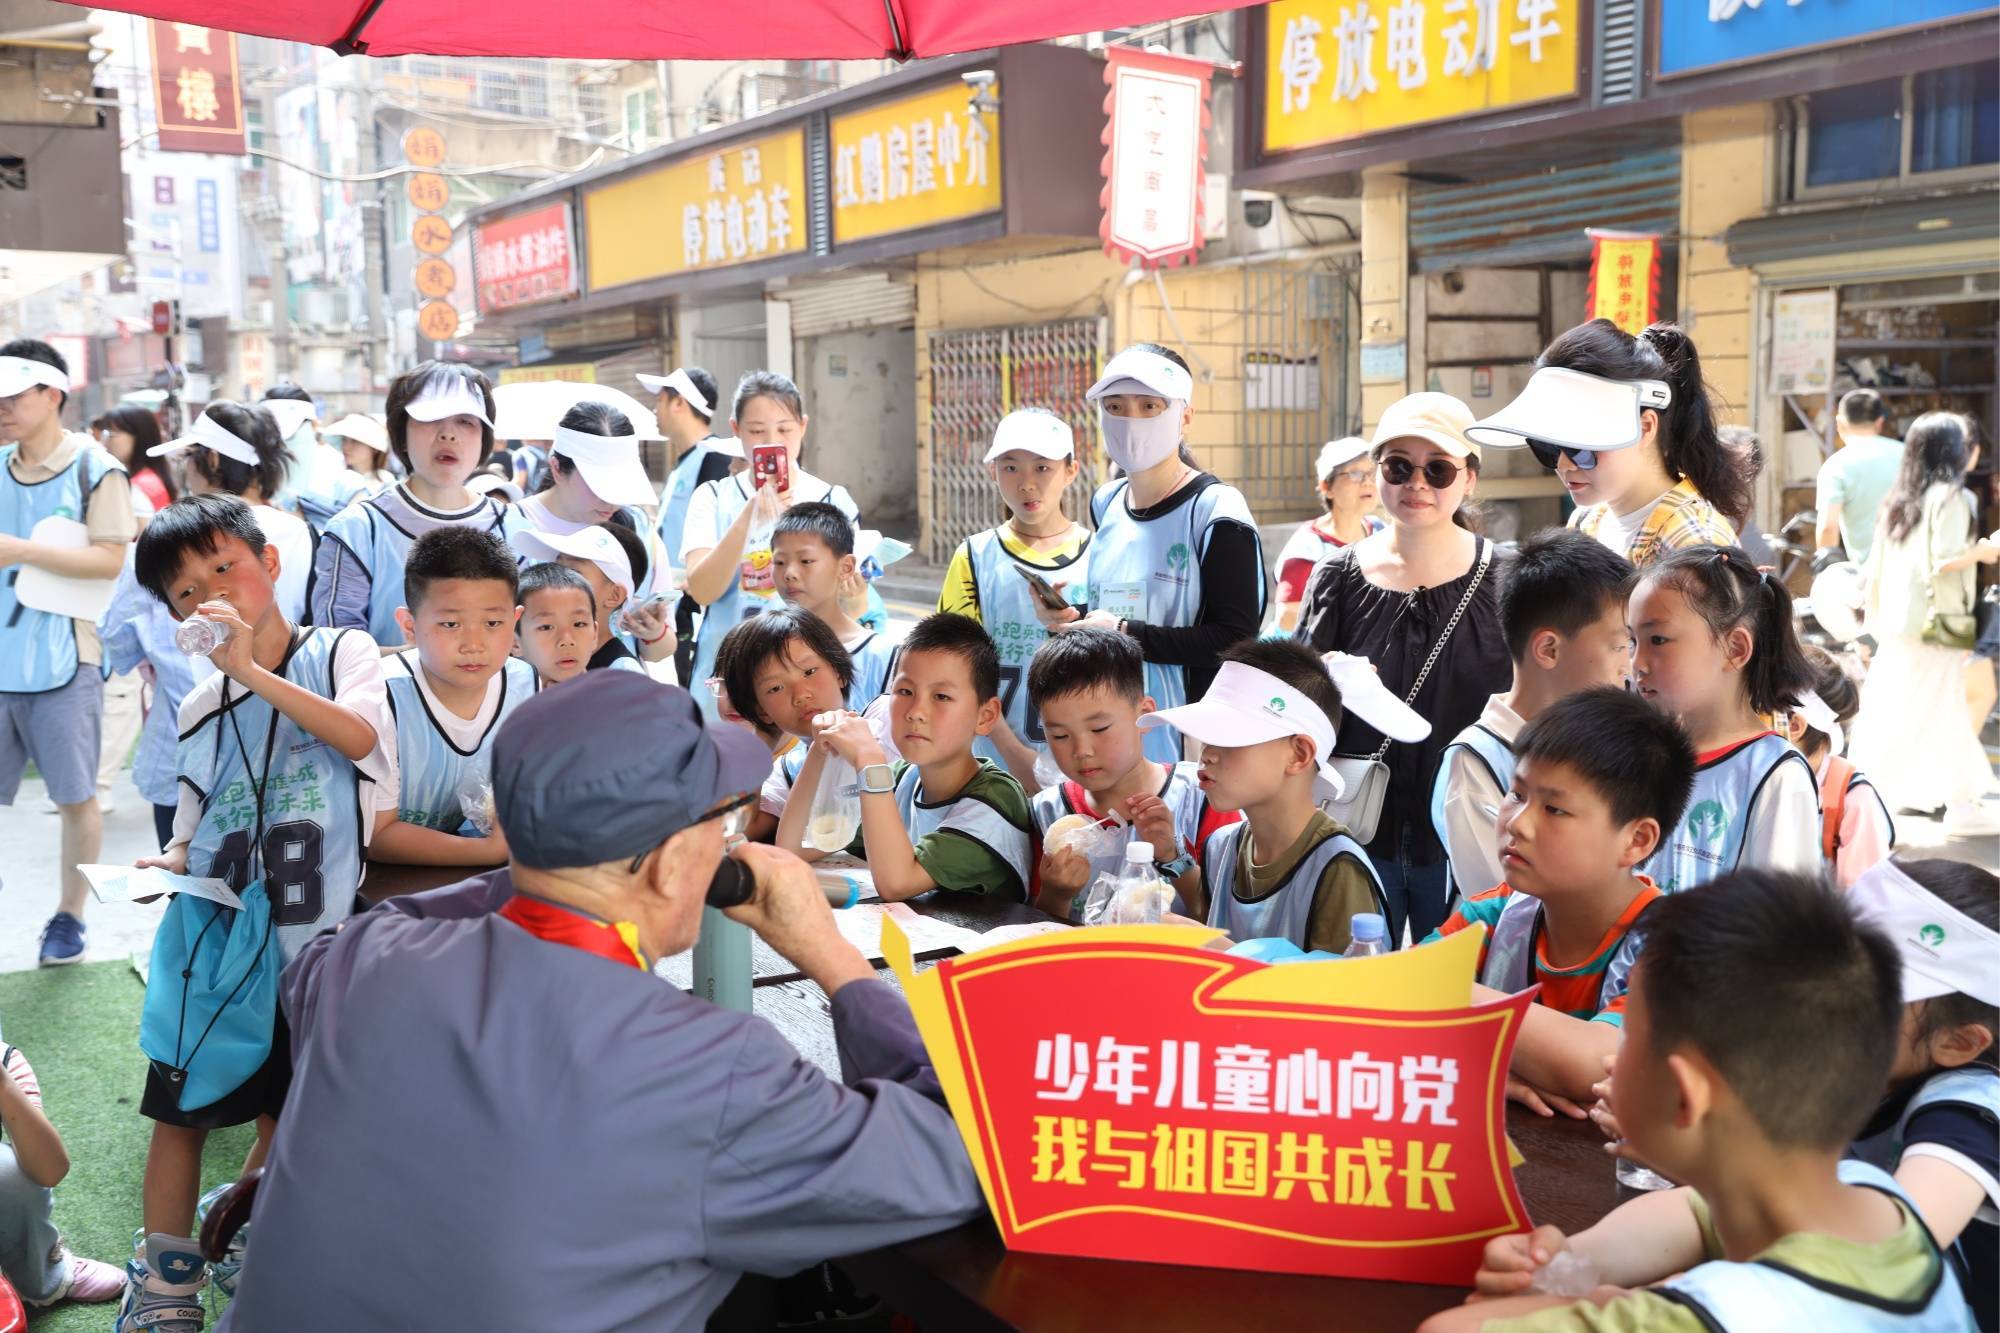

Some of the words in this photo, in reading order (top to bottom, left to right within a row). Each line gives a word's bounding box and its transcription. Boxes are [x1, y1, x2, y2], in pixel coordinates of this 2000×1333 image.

[1279, 0, 1561, 115] 停放电动车
[683, 183, 792, 266] 停放电动车
[1033, 1032, 1460, 1127] 少年儿童心向党
[1030, 1113, 1458, 1213] 我与祖国共成长
